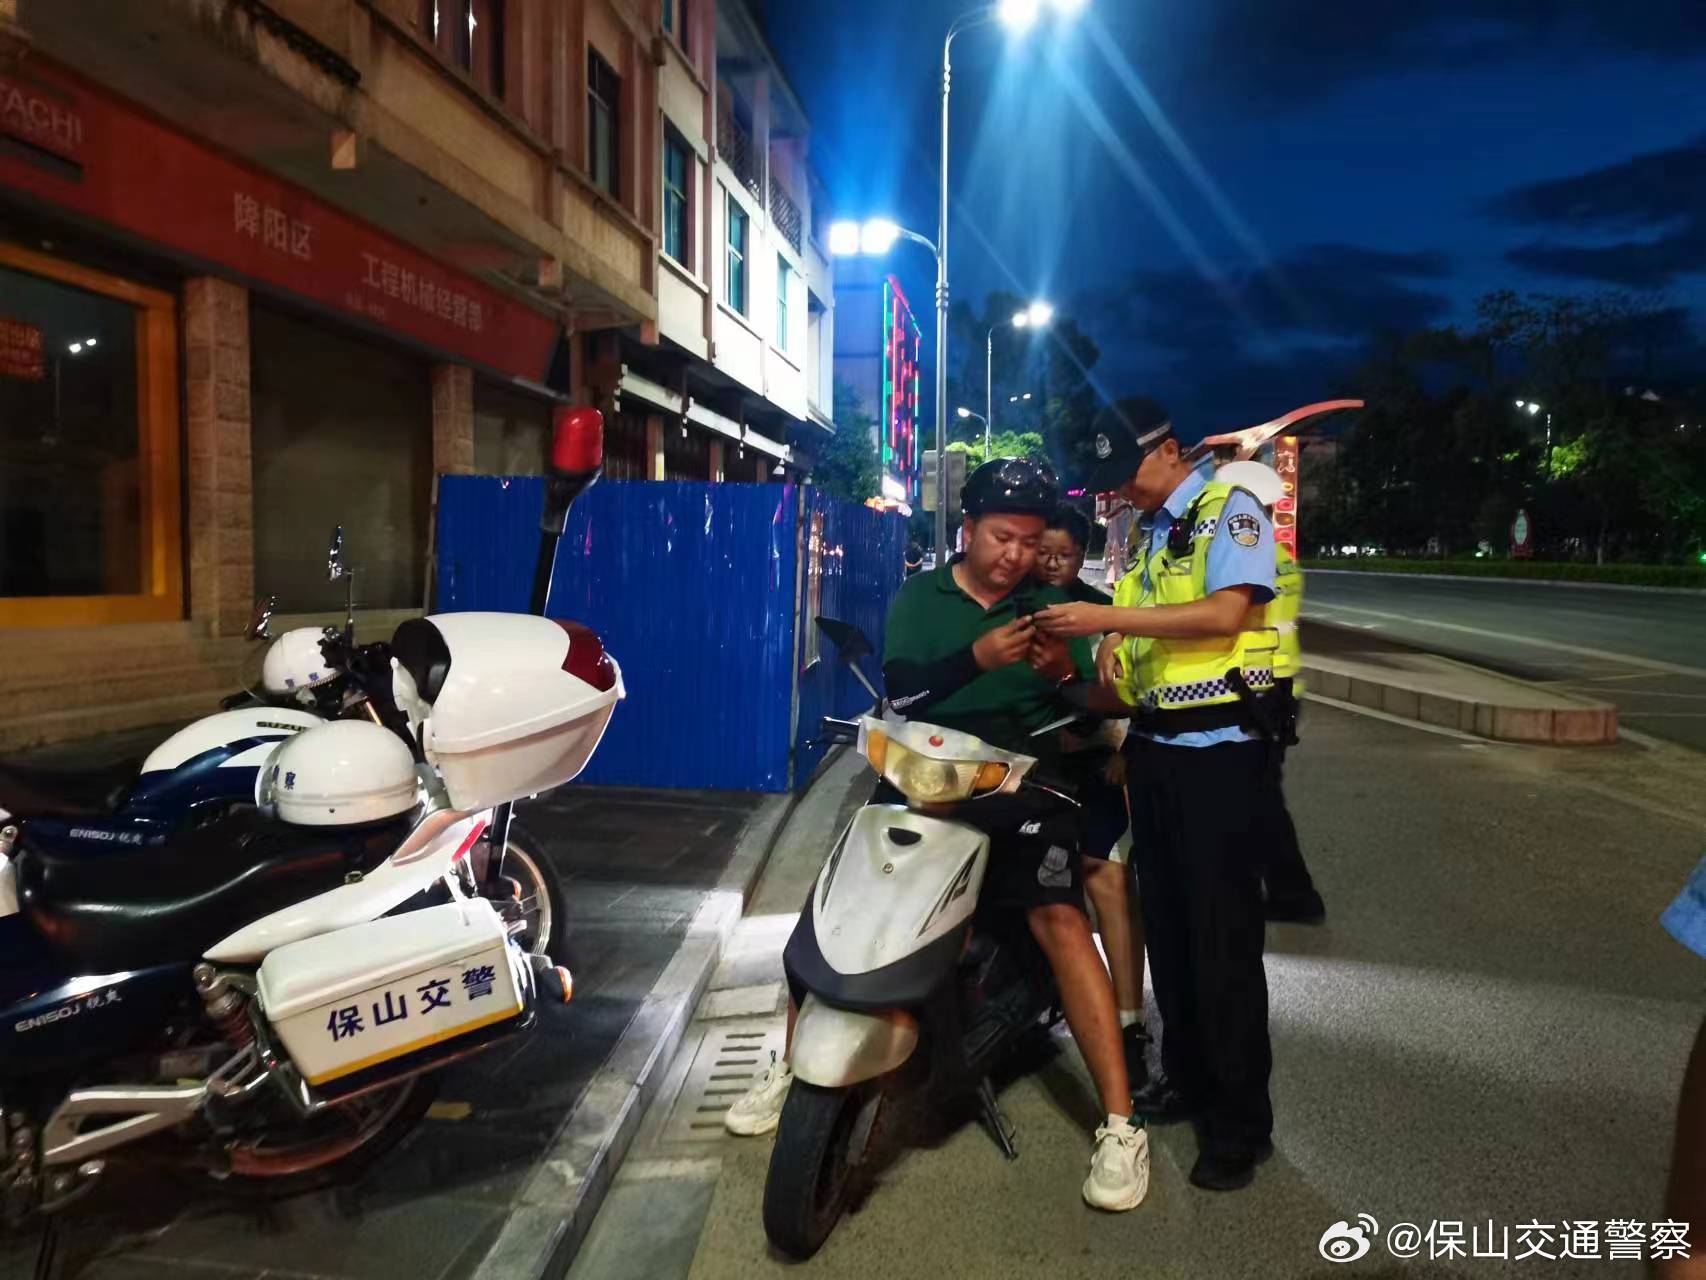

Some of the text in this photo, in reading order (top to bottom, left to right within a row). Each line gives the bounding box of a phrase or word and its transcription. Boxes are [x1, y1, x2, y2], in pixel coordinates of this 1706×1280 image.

[256, 721, 306, 732] SUZU
[327, 965, 496, 1042] 保山交警
